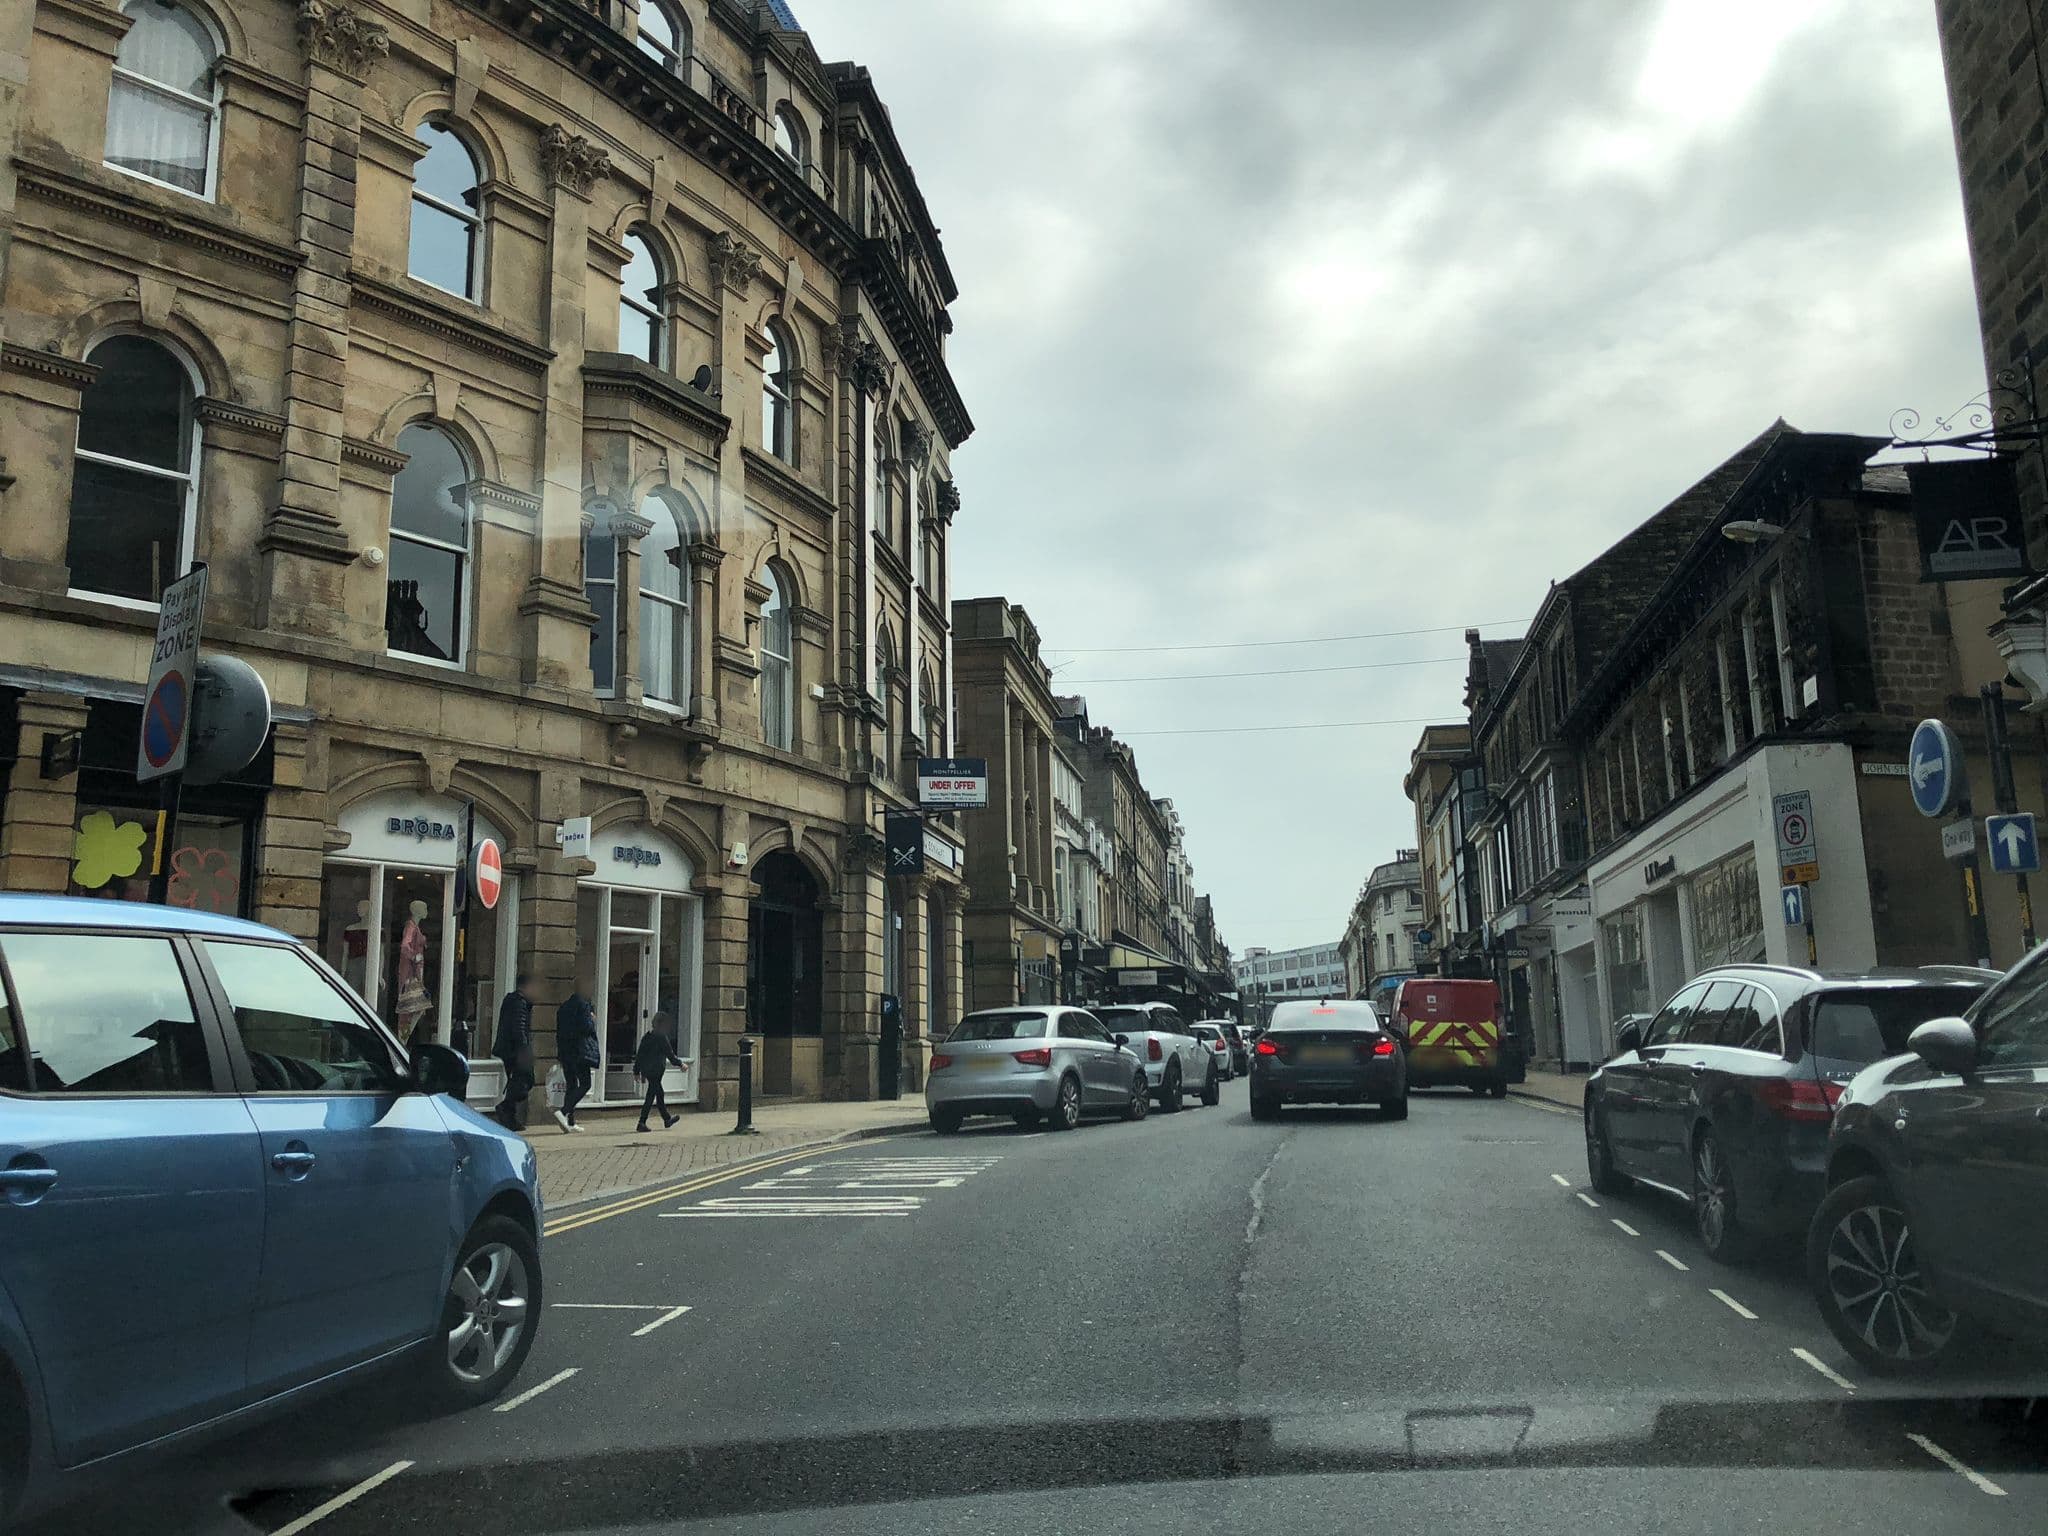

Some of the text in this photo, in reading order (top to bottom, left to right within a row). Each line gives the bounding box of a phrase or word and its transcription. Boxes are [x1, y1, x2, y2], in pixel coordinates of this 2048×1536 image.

[1937, 517, 2012, 553] AR
[165, 592, 181, 607] Pay
[163, 607, 193, 632] Display
[155, 626, 194, 663] ZONE
[1865, 763, 1891, 773] JOHN
[929, 781, 976, 790] UNDER OFFER
[1781, 802, 1804, 813] ZONE
[388, 817, 455, 840] BRORA
[565, 833, 584, 841] BRORA
[614, 846, 661, 866] BRORA
[884, 1001, 890, 1012] P
